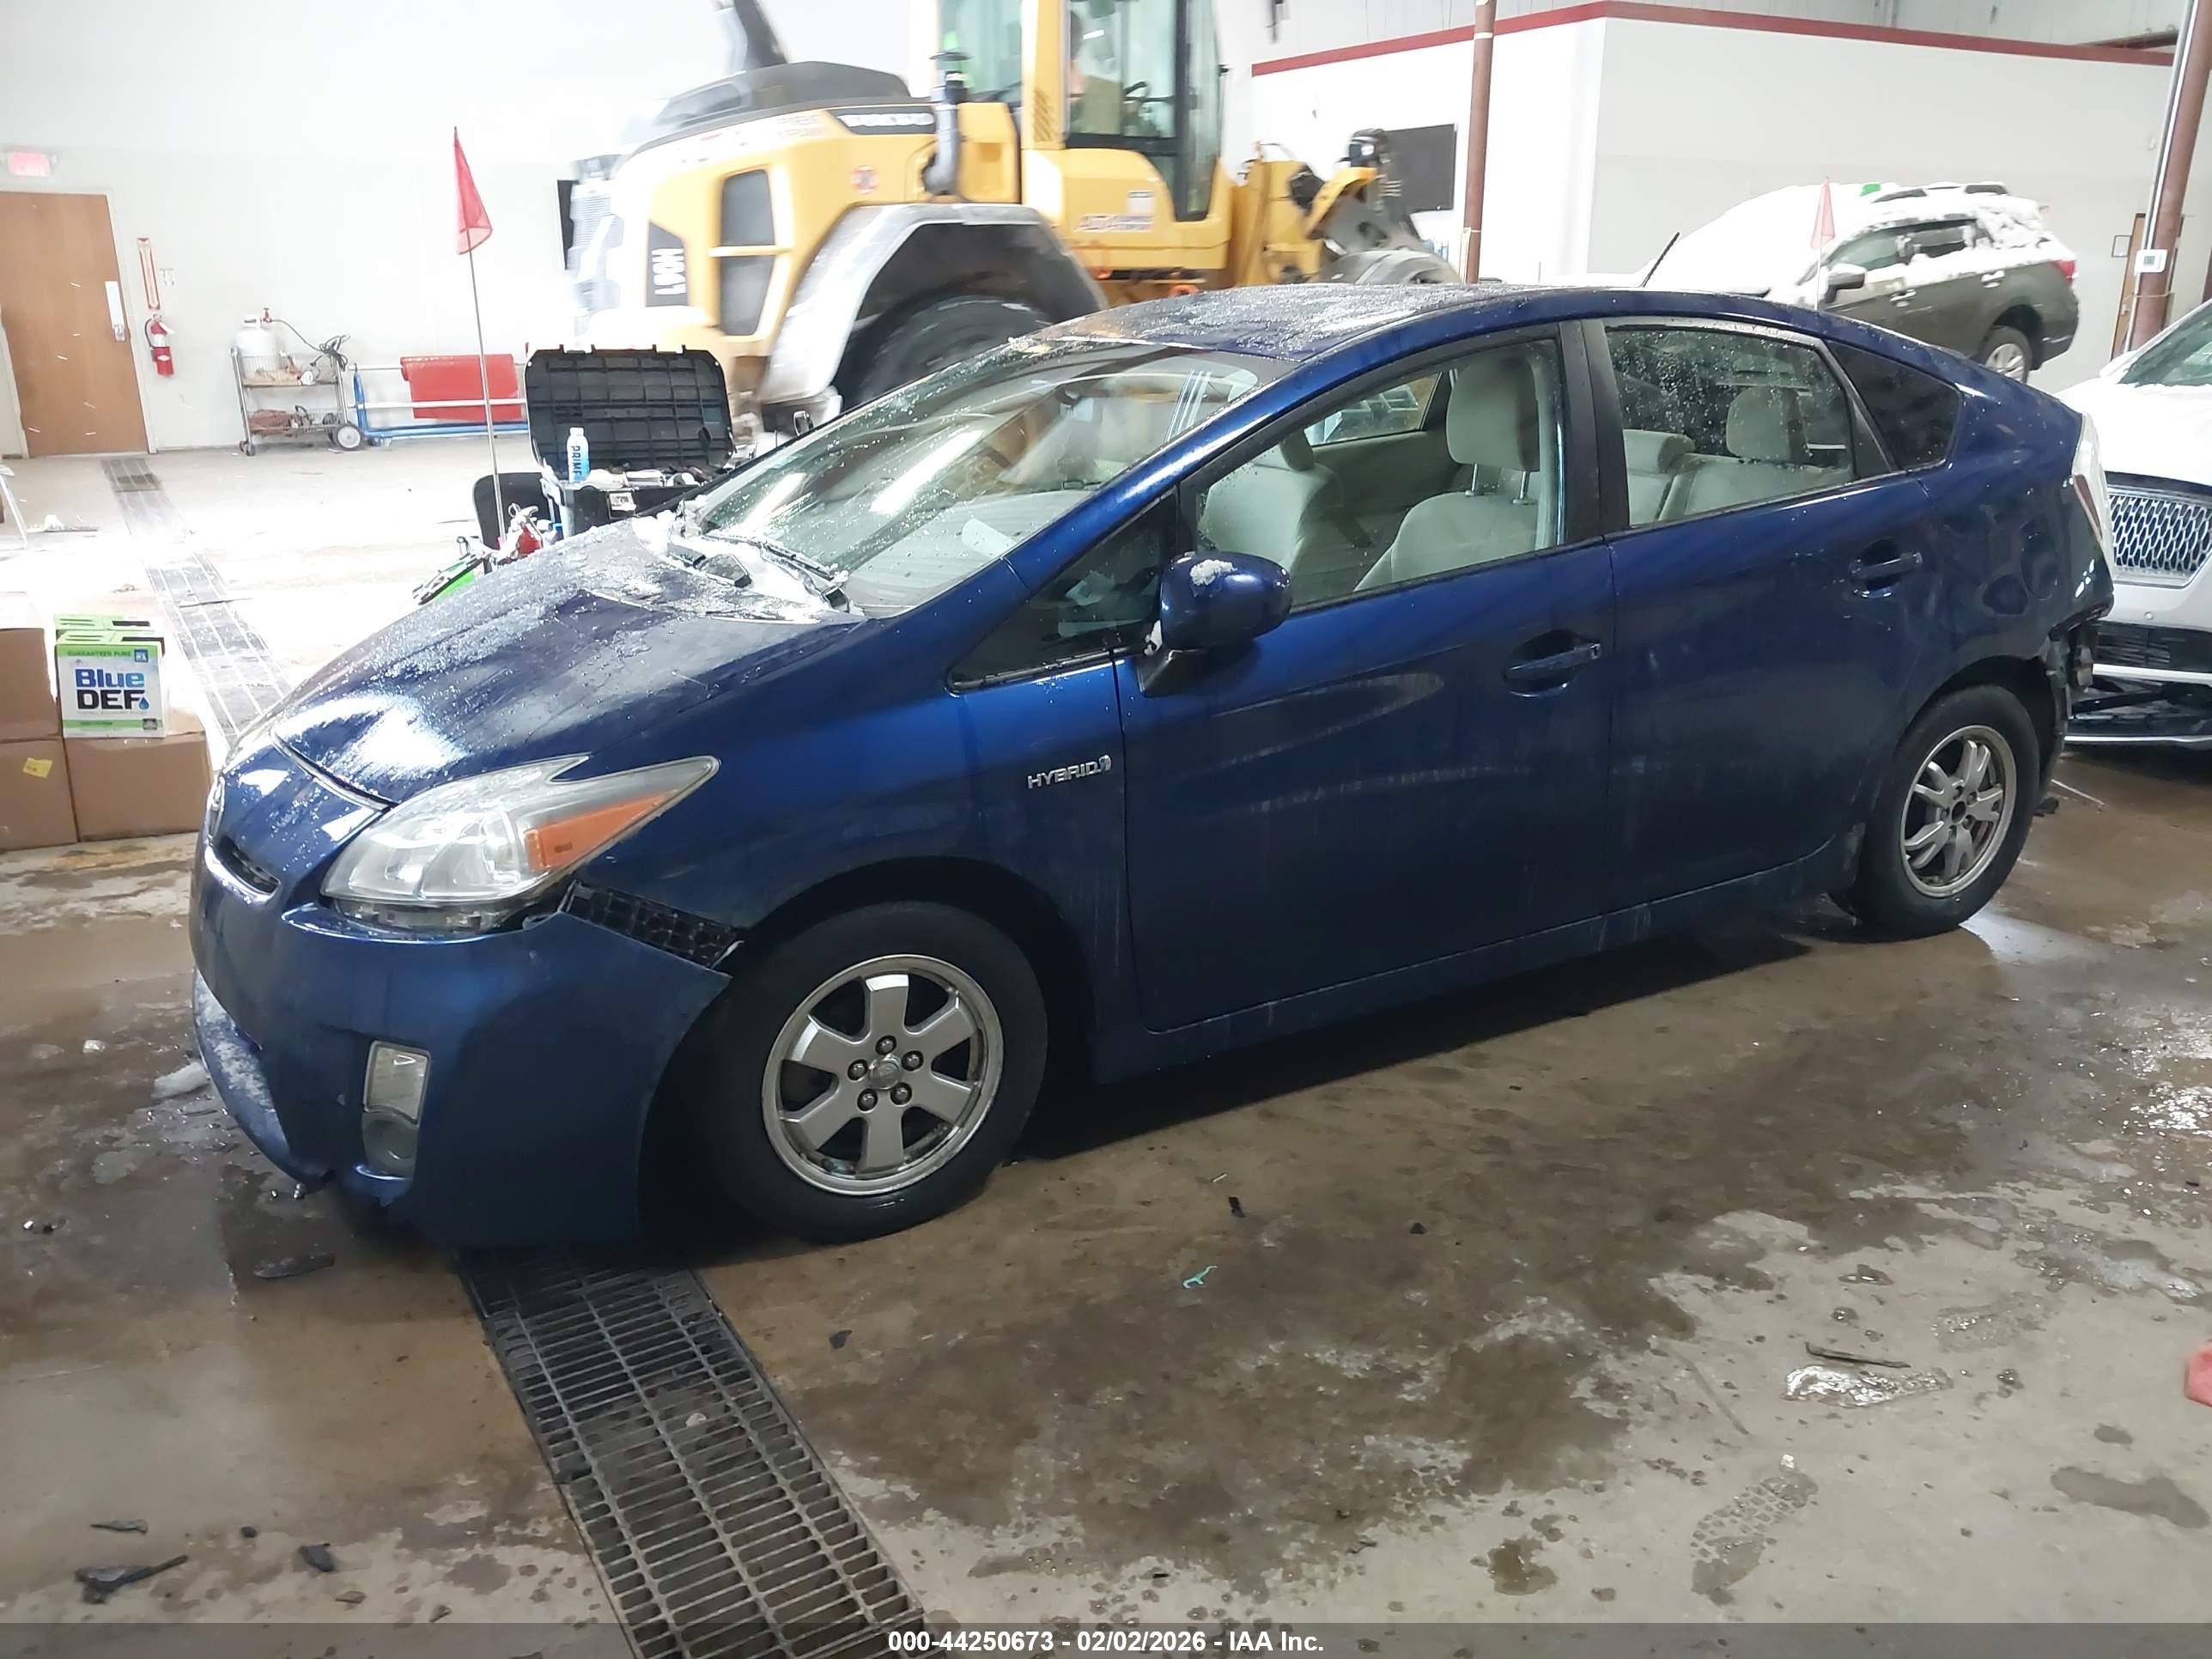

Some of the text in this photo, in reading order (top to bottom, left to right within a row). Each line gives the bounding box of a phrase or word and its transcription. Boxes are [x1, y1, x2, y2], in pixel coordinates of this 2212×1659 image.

[75, 668, 145, 688] Blue
[76, 689, 145, 710] DEF
[1027, 761, 1100, 790] HYBRID
